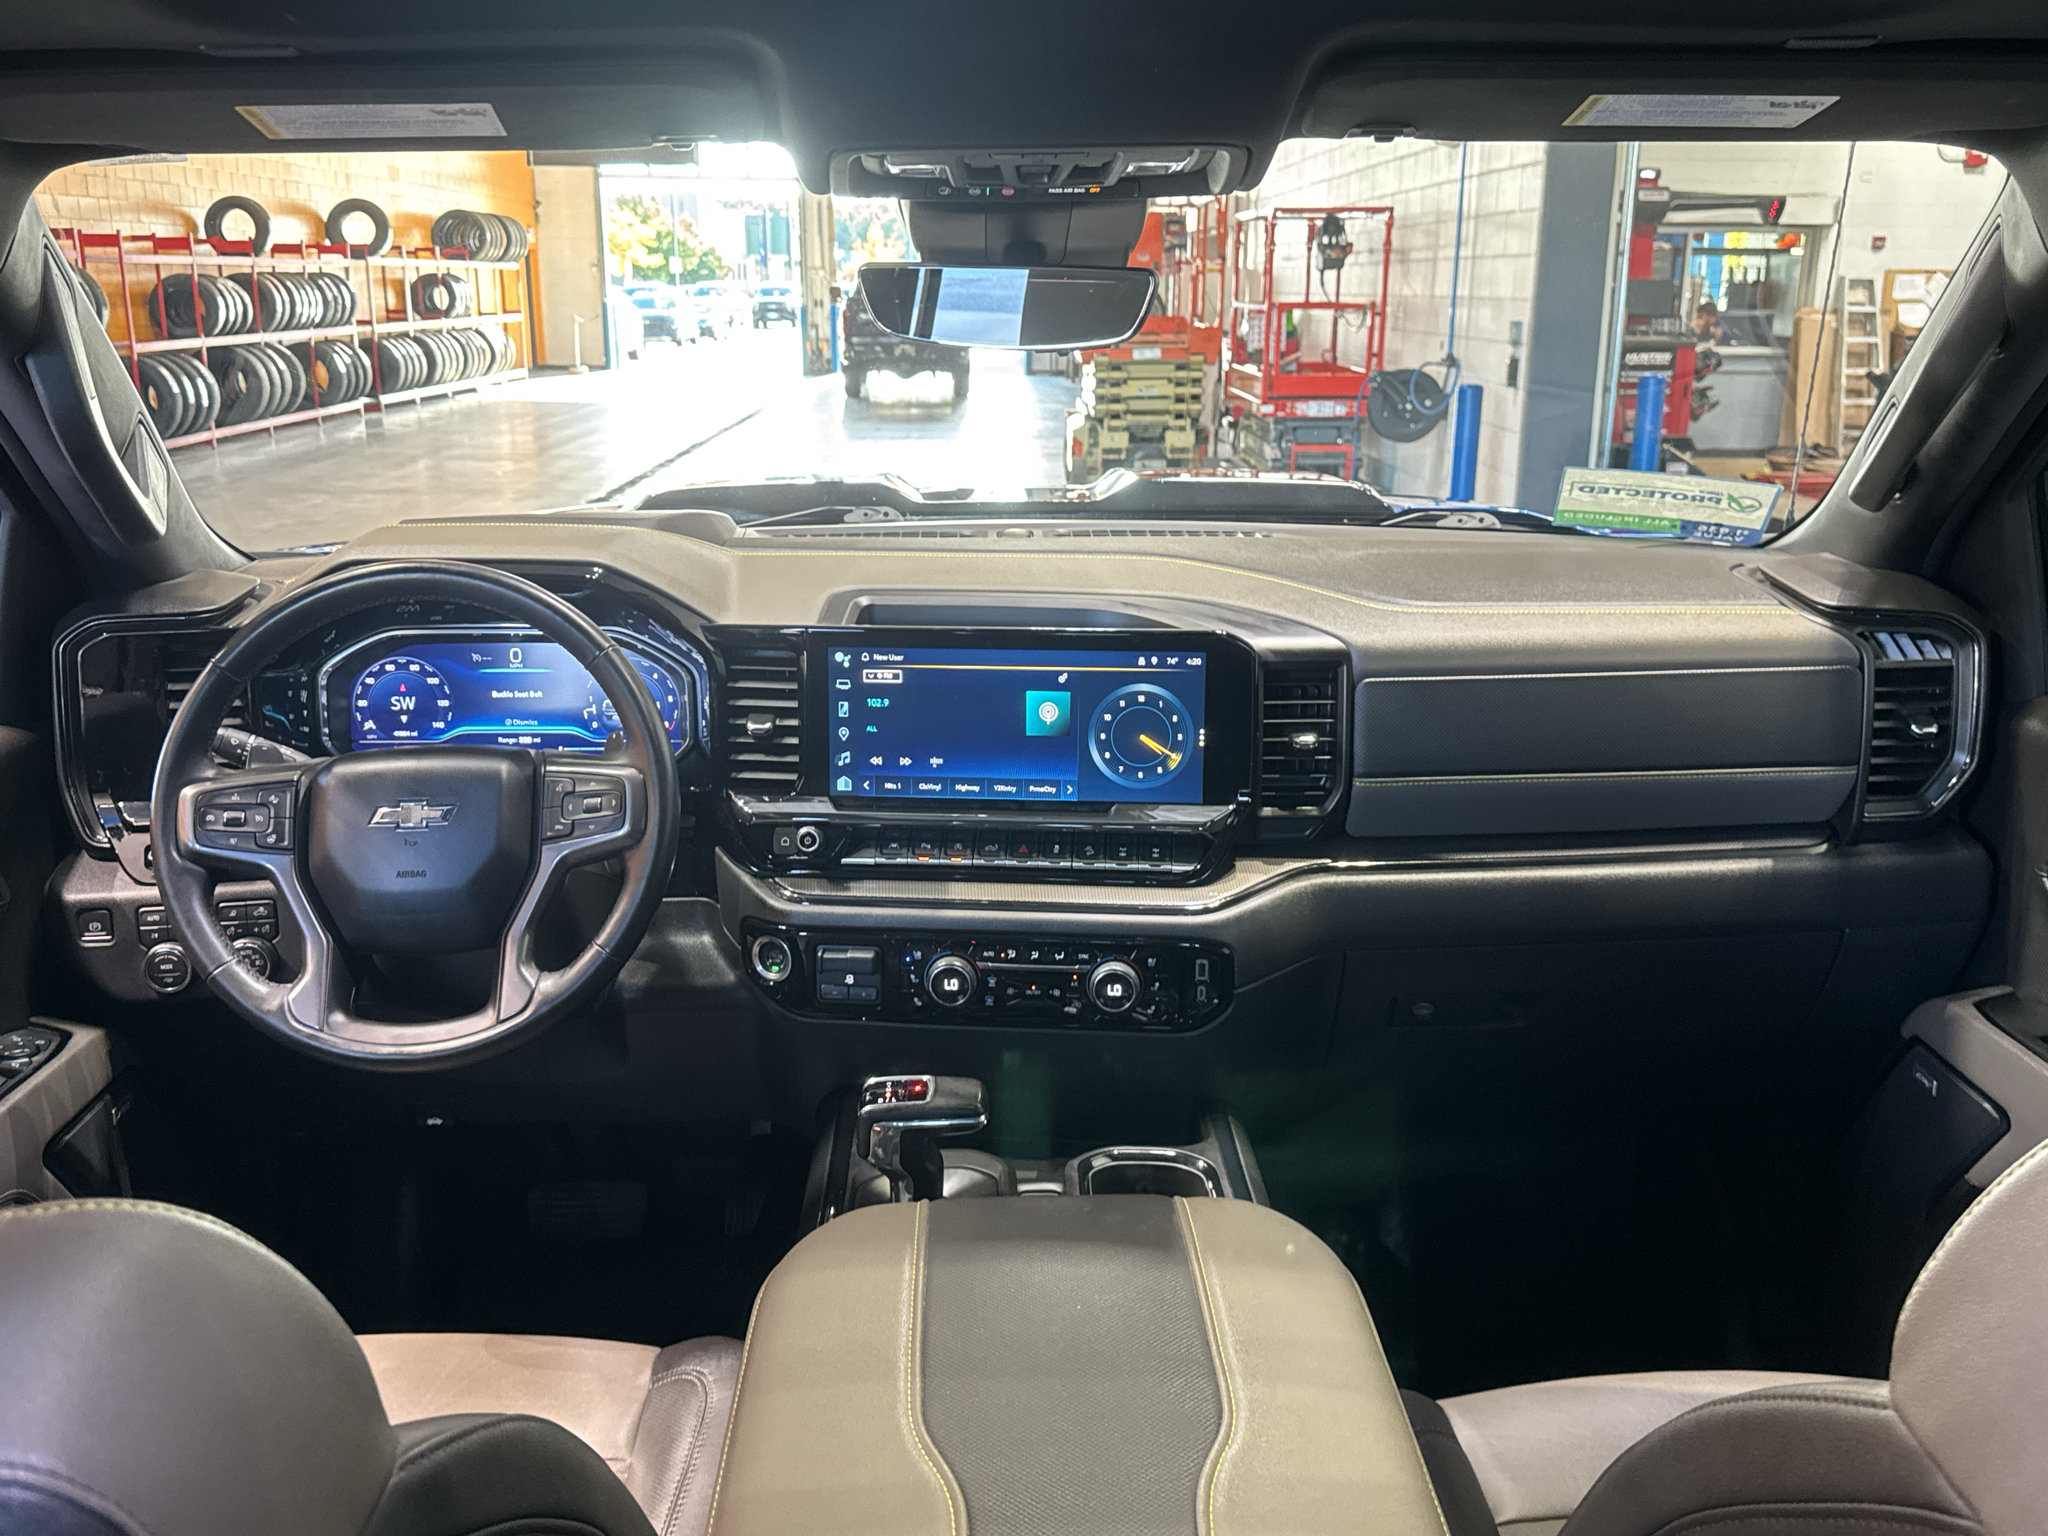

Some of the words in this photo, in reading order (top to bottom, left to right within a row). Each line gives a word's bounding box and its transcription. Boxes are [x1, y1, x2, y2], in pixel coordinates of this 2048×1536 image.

[509, 647, 522, 663] 0
[873, 653, 888, 661] New
[888, 653, 904, 661] User
[1185, 657, 1202, 666] 4:20
[426, 677, 440, 685] 100
[390, 695, 416, 711] SW
[866, 698, 889, 707] 102.9
[432, 721, 445, 729] 140
[955, 784, 980, 793] Highway
[395, 870, 427, 878] AIRBAG
[944, 978, 959, 991] LO
[1106, 984, 1122, 997] LO
